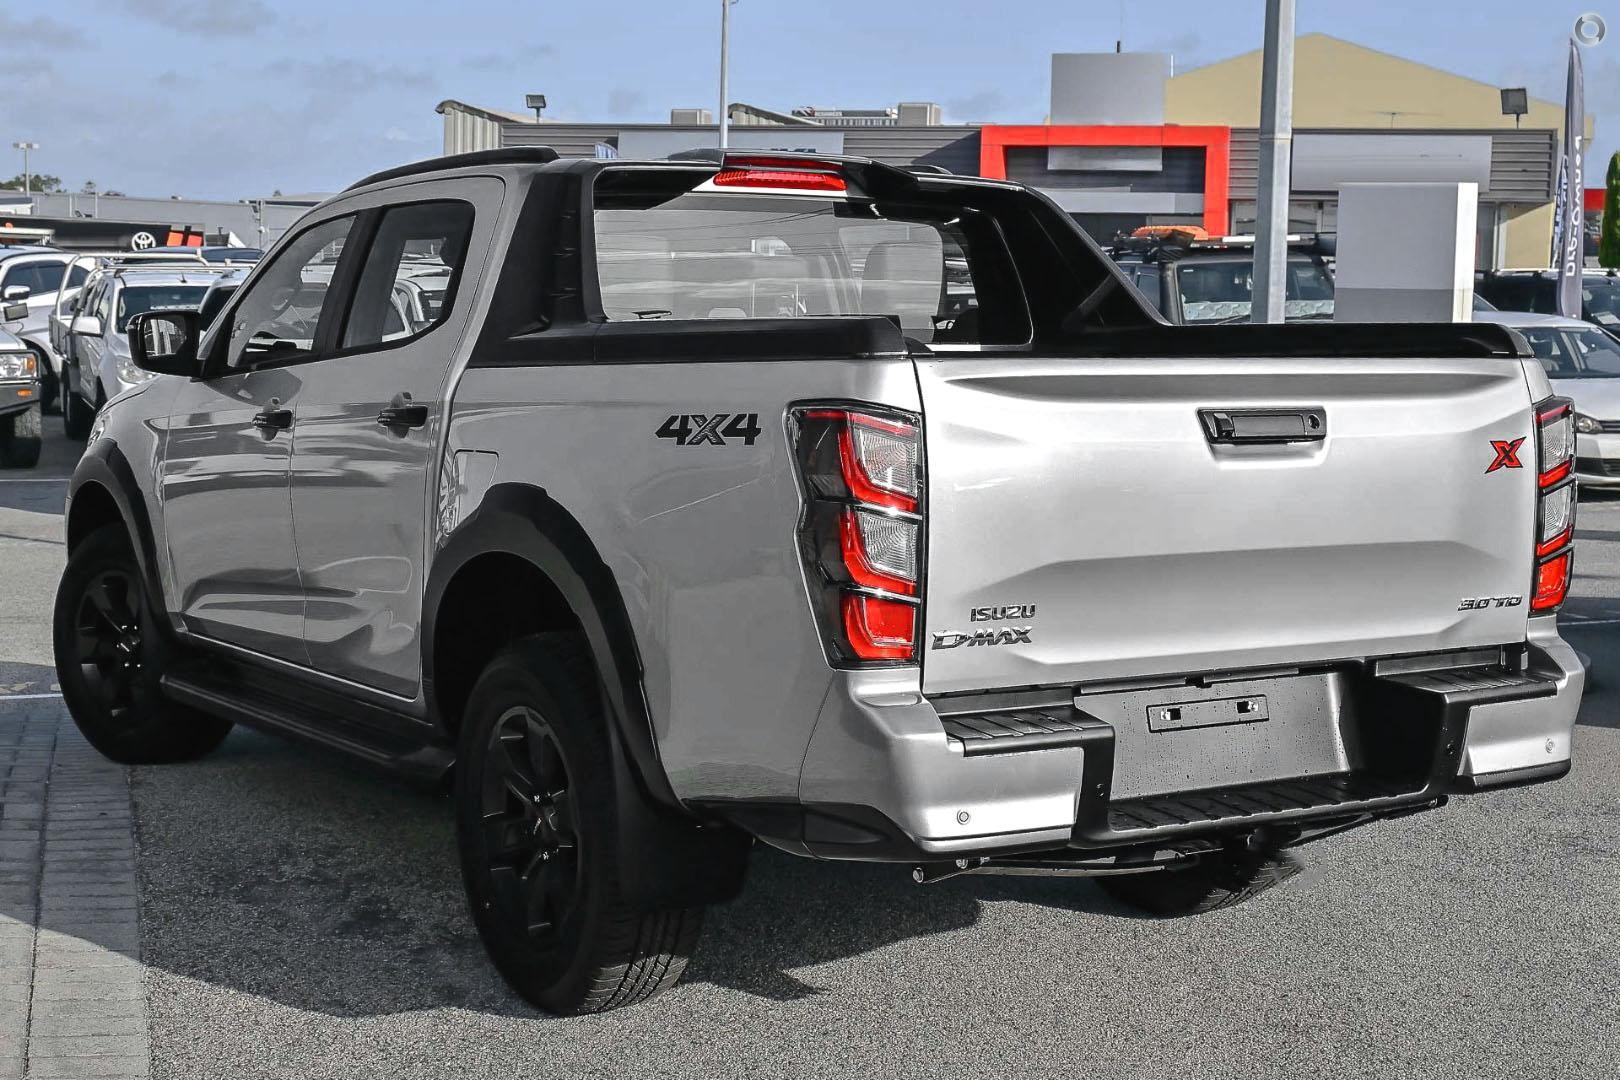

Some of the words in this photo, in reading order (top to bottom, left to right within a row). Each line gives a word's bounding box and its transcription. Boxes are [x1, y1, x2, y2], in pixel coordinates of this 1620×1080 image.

[655, 413, 762, 446] 4X4
[1484, 436, 1527, 474] X
[970, 603, 1036, 622] ISUZU
[931, 626, 1033, 650] D-MAX
